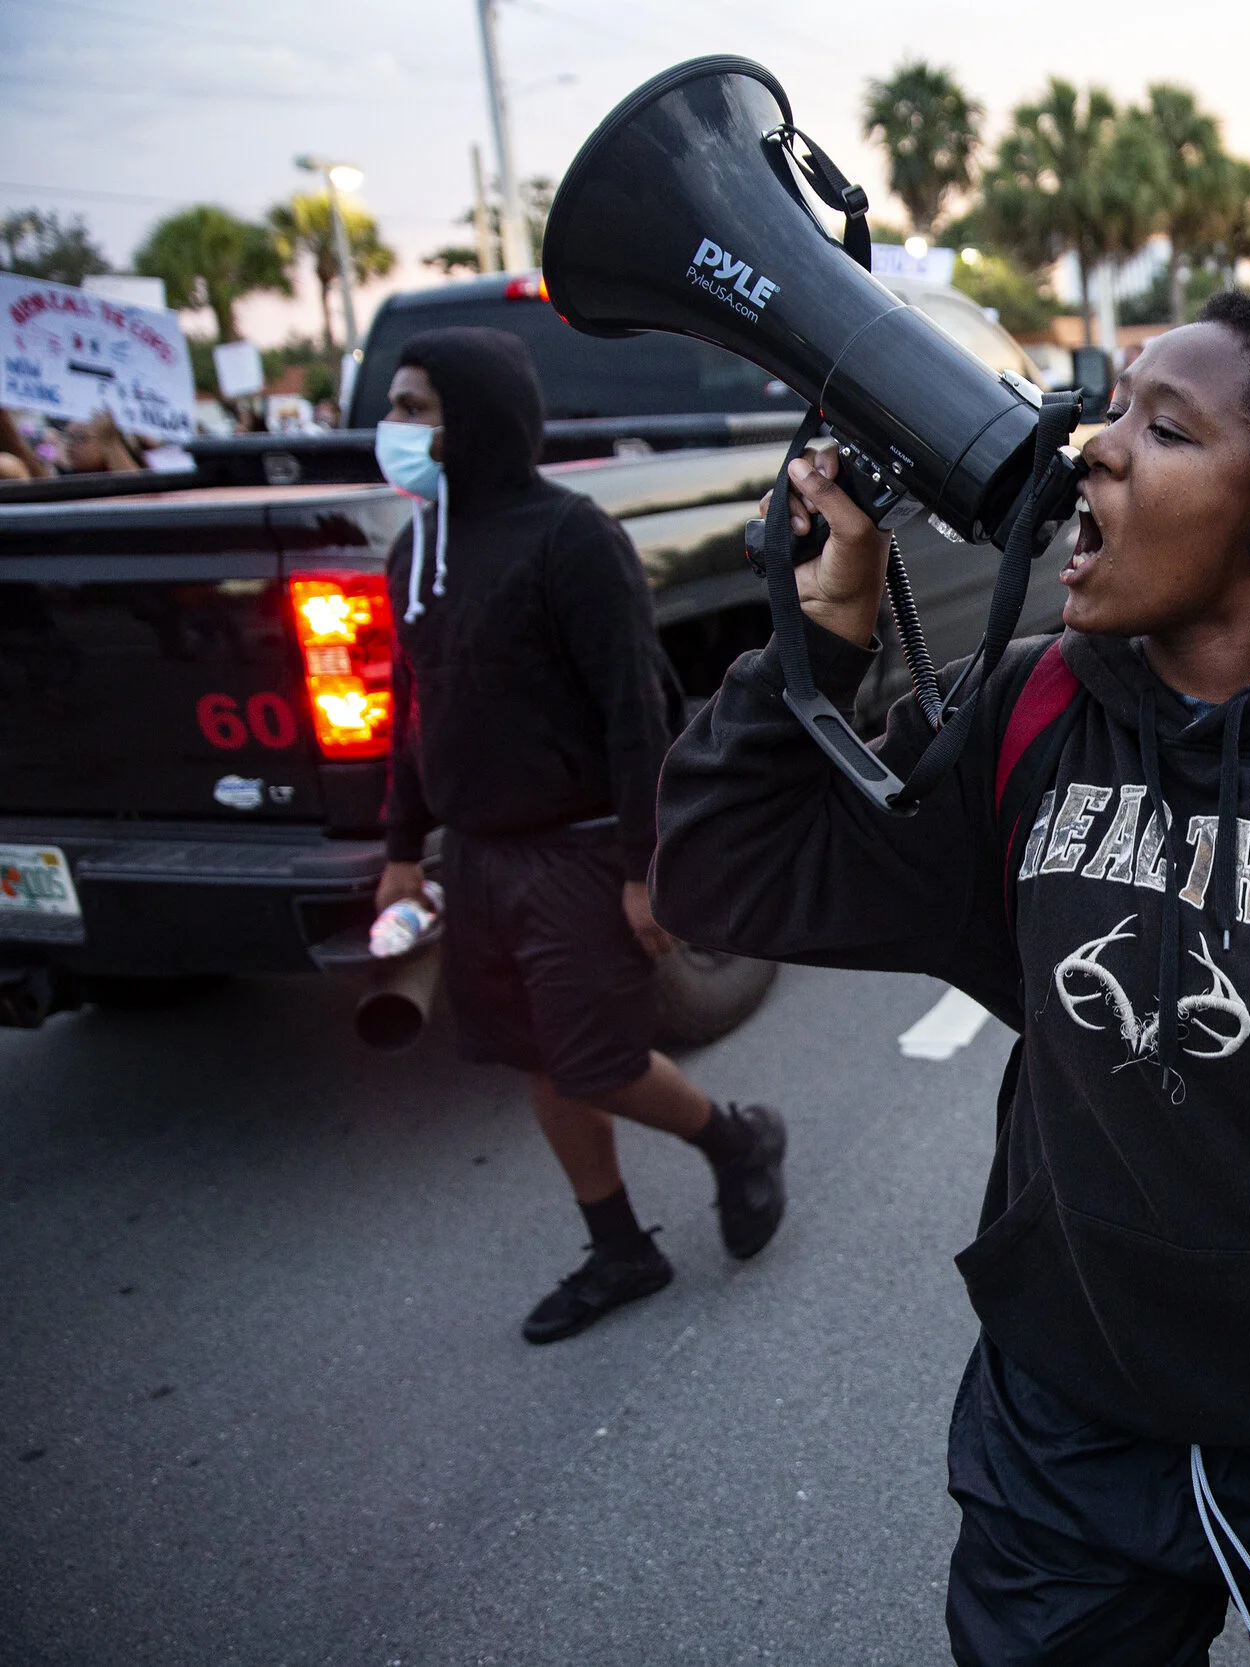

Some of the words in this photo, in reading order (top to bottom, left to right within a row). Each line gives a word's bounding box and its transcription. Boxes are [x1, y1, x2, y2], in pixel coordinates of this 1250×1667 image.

[686, 266, 759, 323] PyleUSA.com
[693, 238, 777, 309] PYLE
[196, 692, 297, 749] 60
